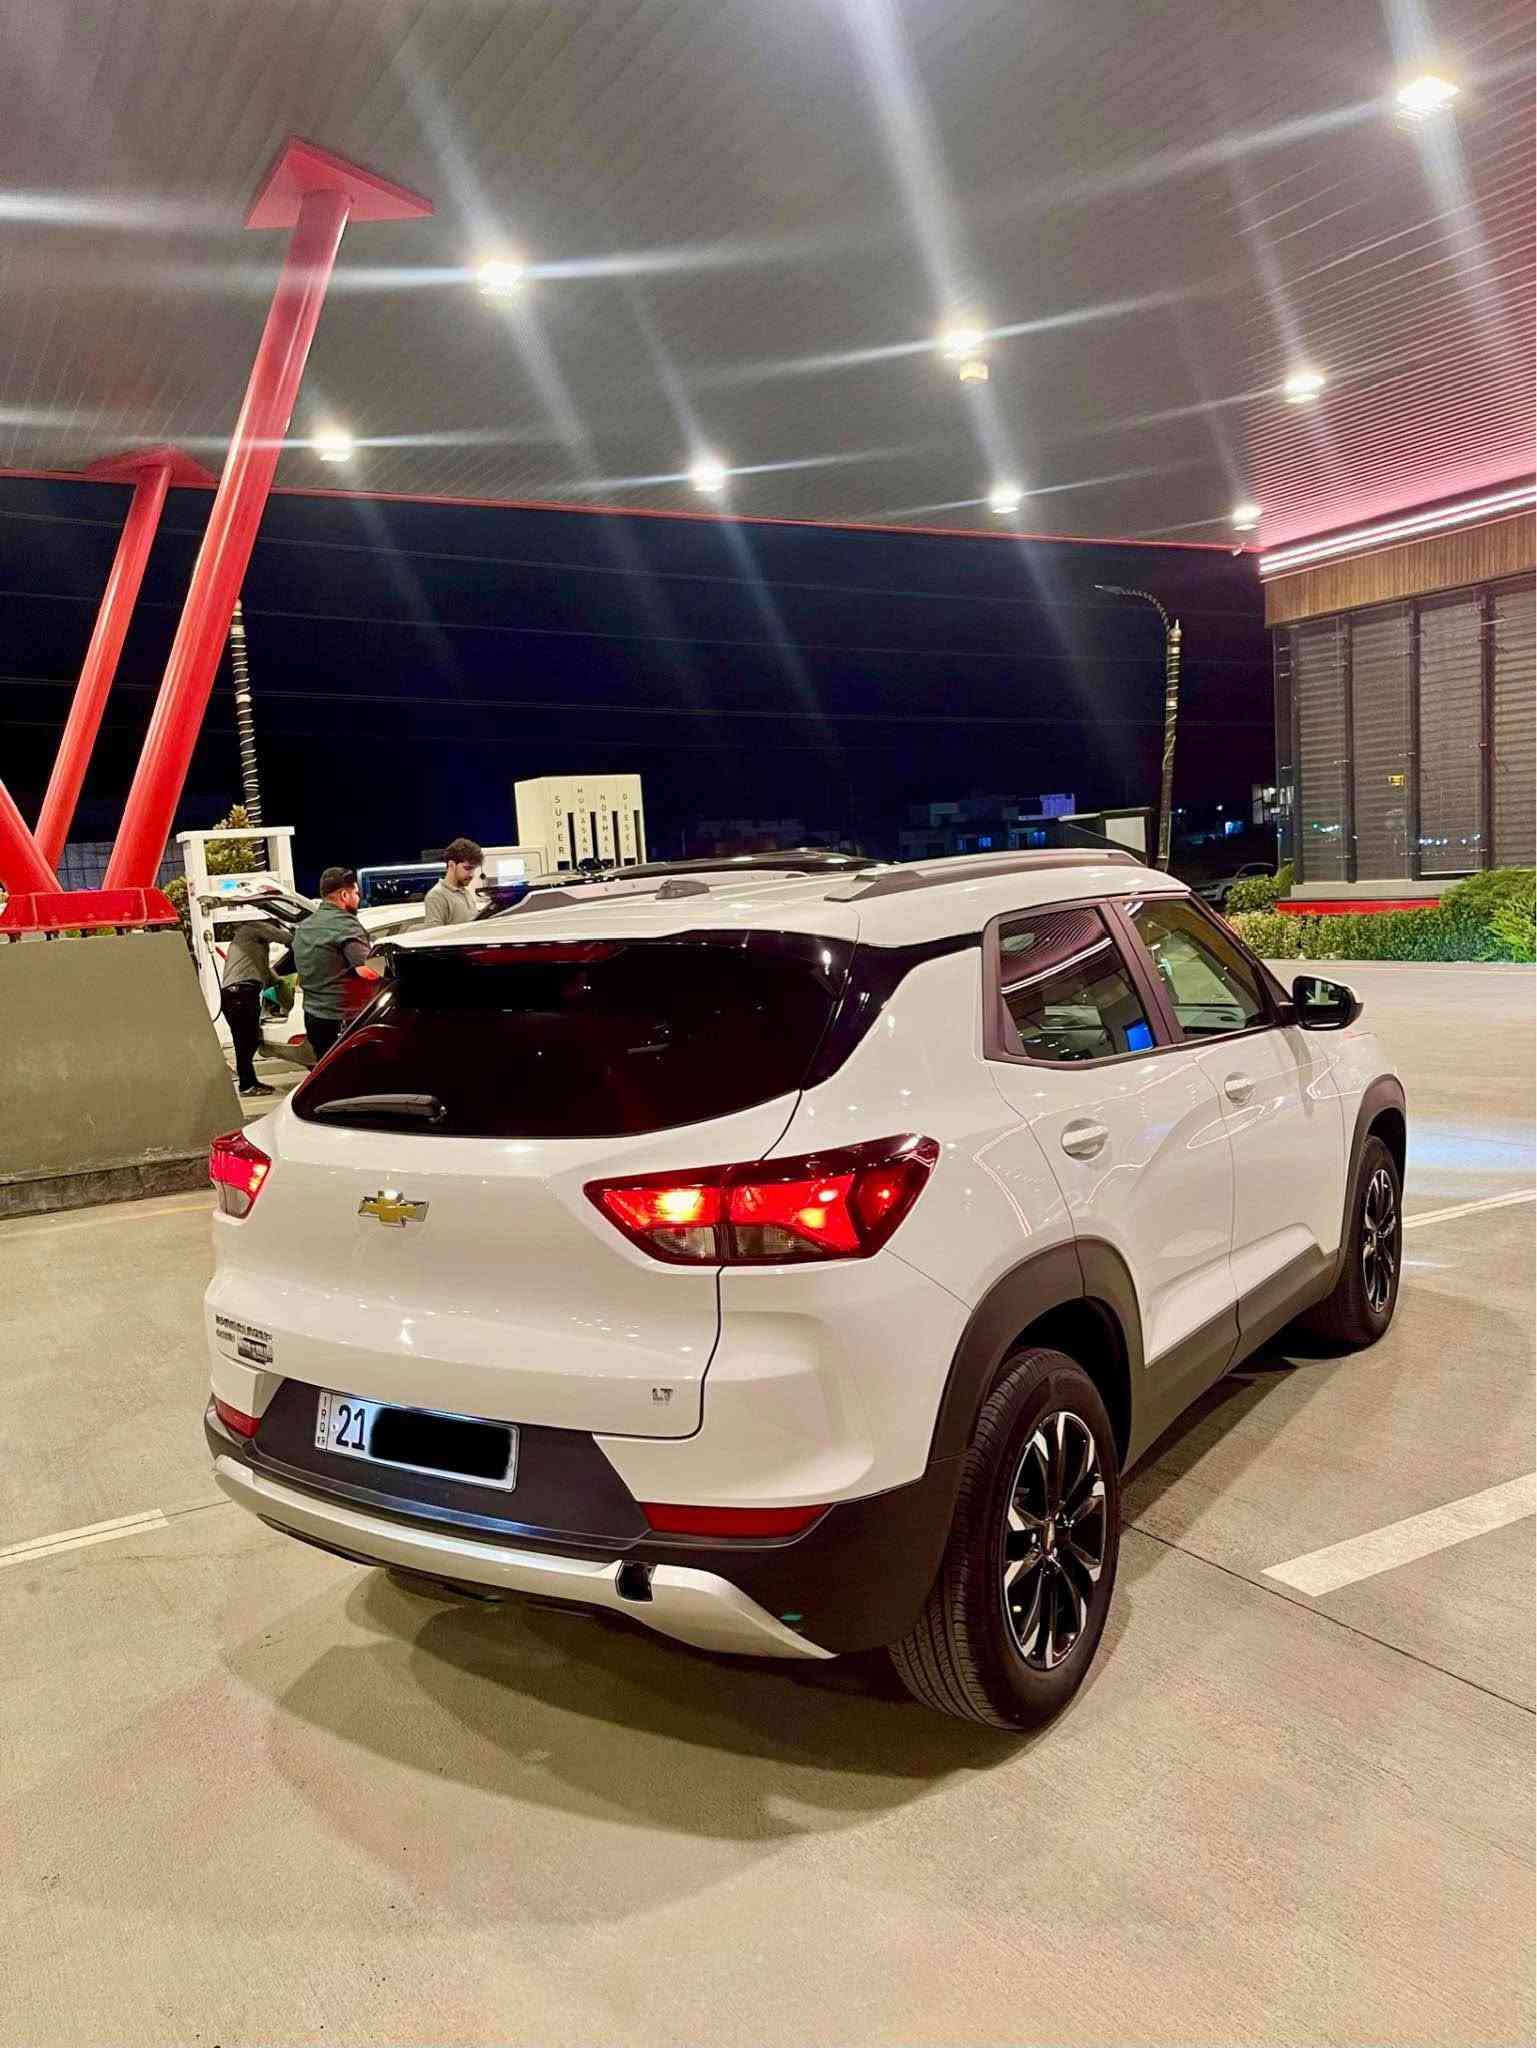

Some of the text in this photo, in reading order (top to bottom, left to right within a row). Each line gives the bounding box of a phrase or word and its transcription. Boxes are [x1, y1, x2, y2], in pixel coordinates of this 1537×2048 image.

[554, 795, 564, 854] SUPER
[600, 794, 609, 852] NORMAL
[652, 1388, 673, 1401] LT
[336, 1404, 366, 1451] 21
